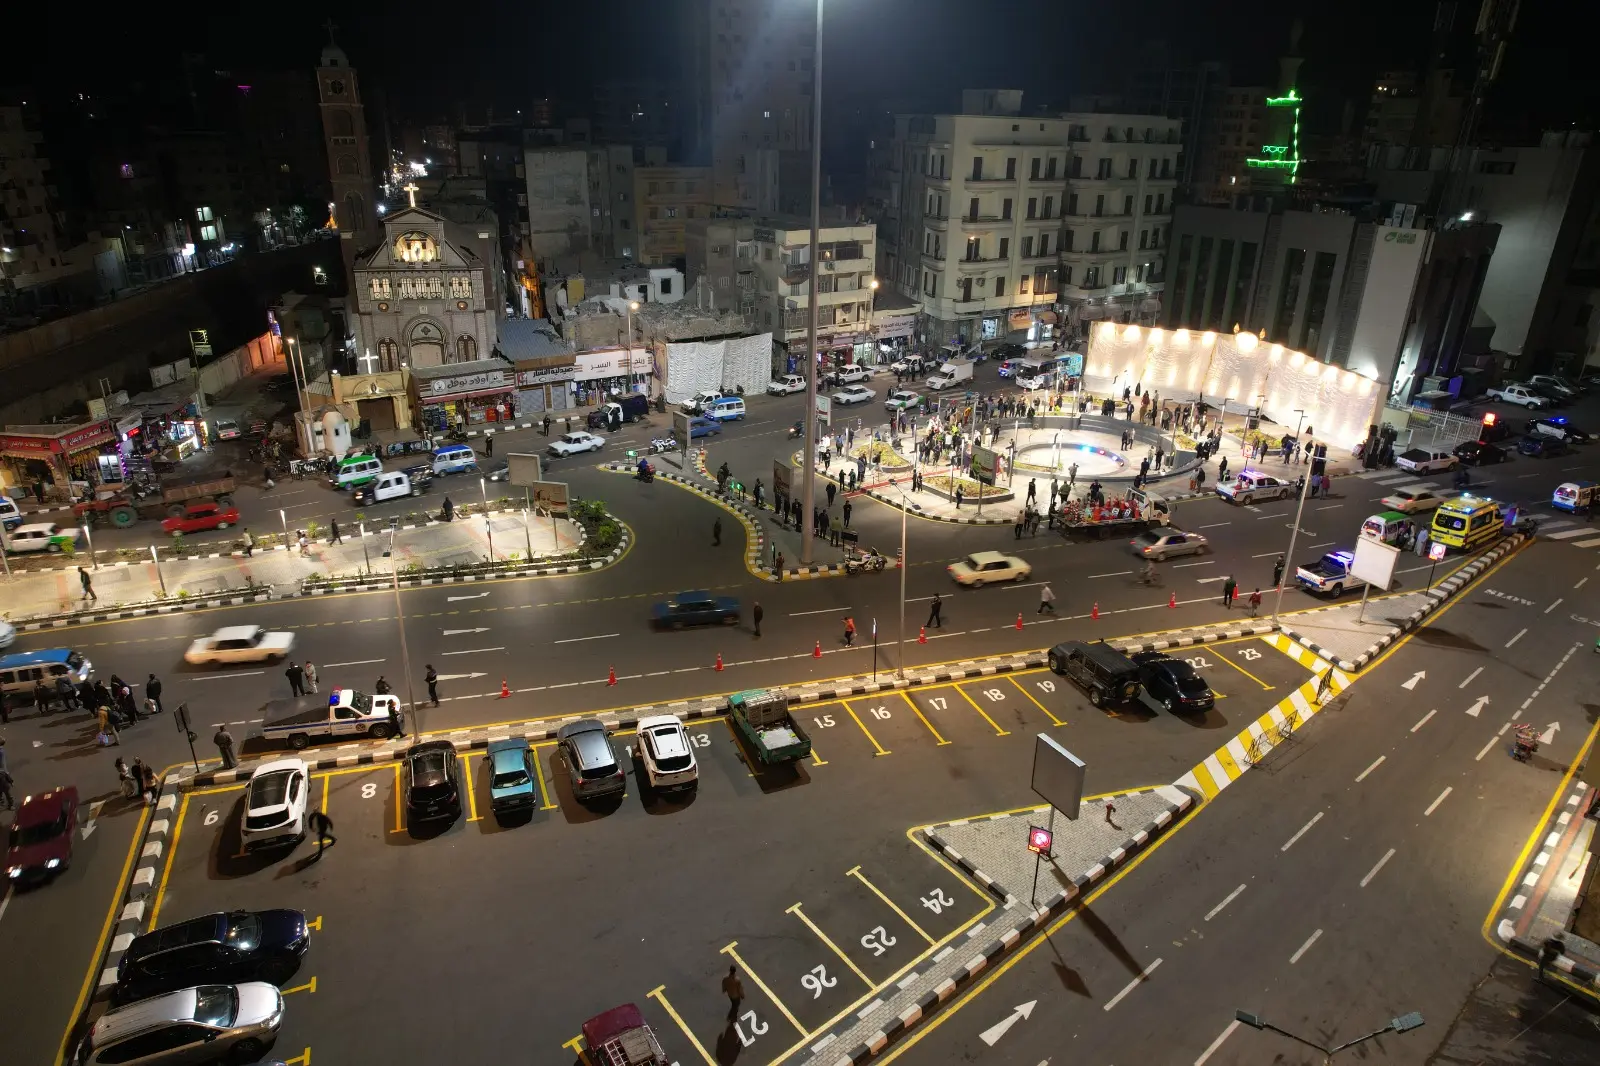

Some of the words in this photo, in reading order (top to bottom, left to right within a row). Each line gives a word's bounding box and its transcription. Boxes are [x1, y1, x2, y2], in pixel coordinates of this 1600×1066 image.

[1238, 648, 1262, 660] 23
[1185, 657, 1214, 669] 22
[1036, 680, 1057, 694] 19
[983, 688, 1006, 703] 18
[929, 697, 948, 712] 17
[870, 706, 892, 721] 16
[813, 714, 836, 729] 15
[690, 733, 712, 749] 13
[360, 783, 377, 799] 8
[203, 809, 219, 826] 6
[919, 887, 955, 915] 24
[860, 926, 897, 957] 25
[800, 964, 838, 999] 26
[733, 1009, 769, 1048] 27
